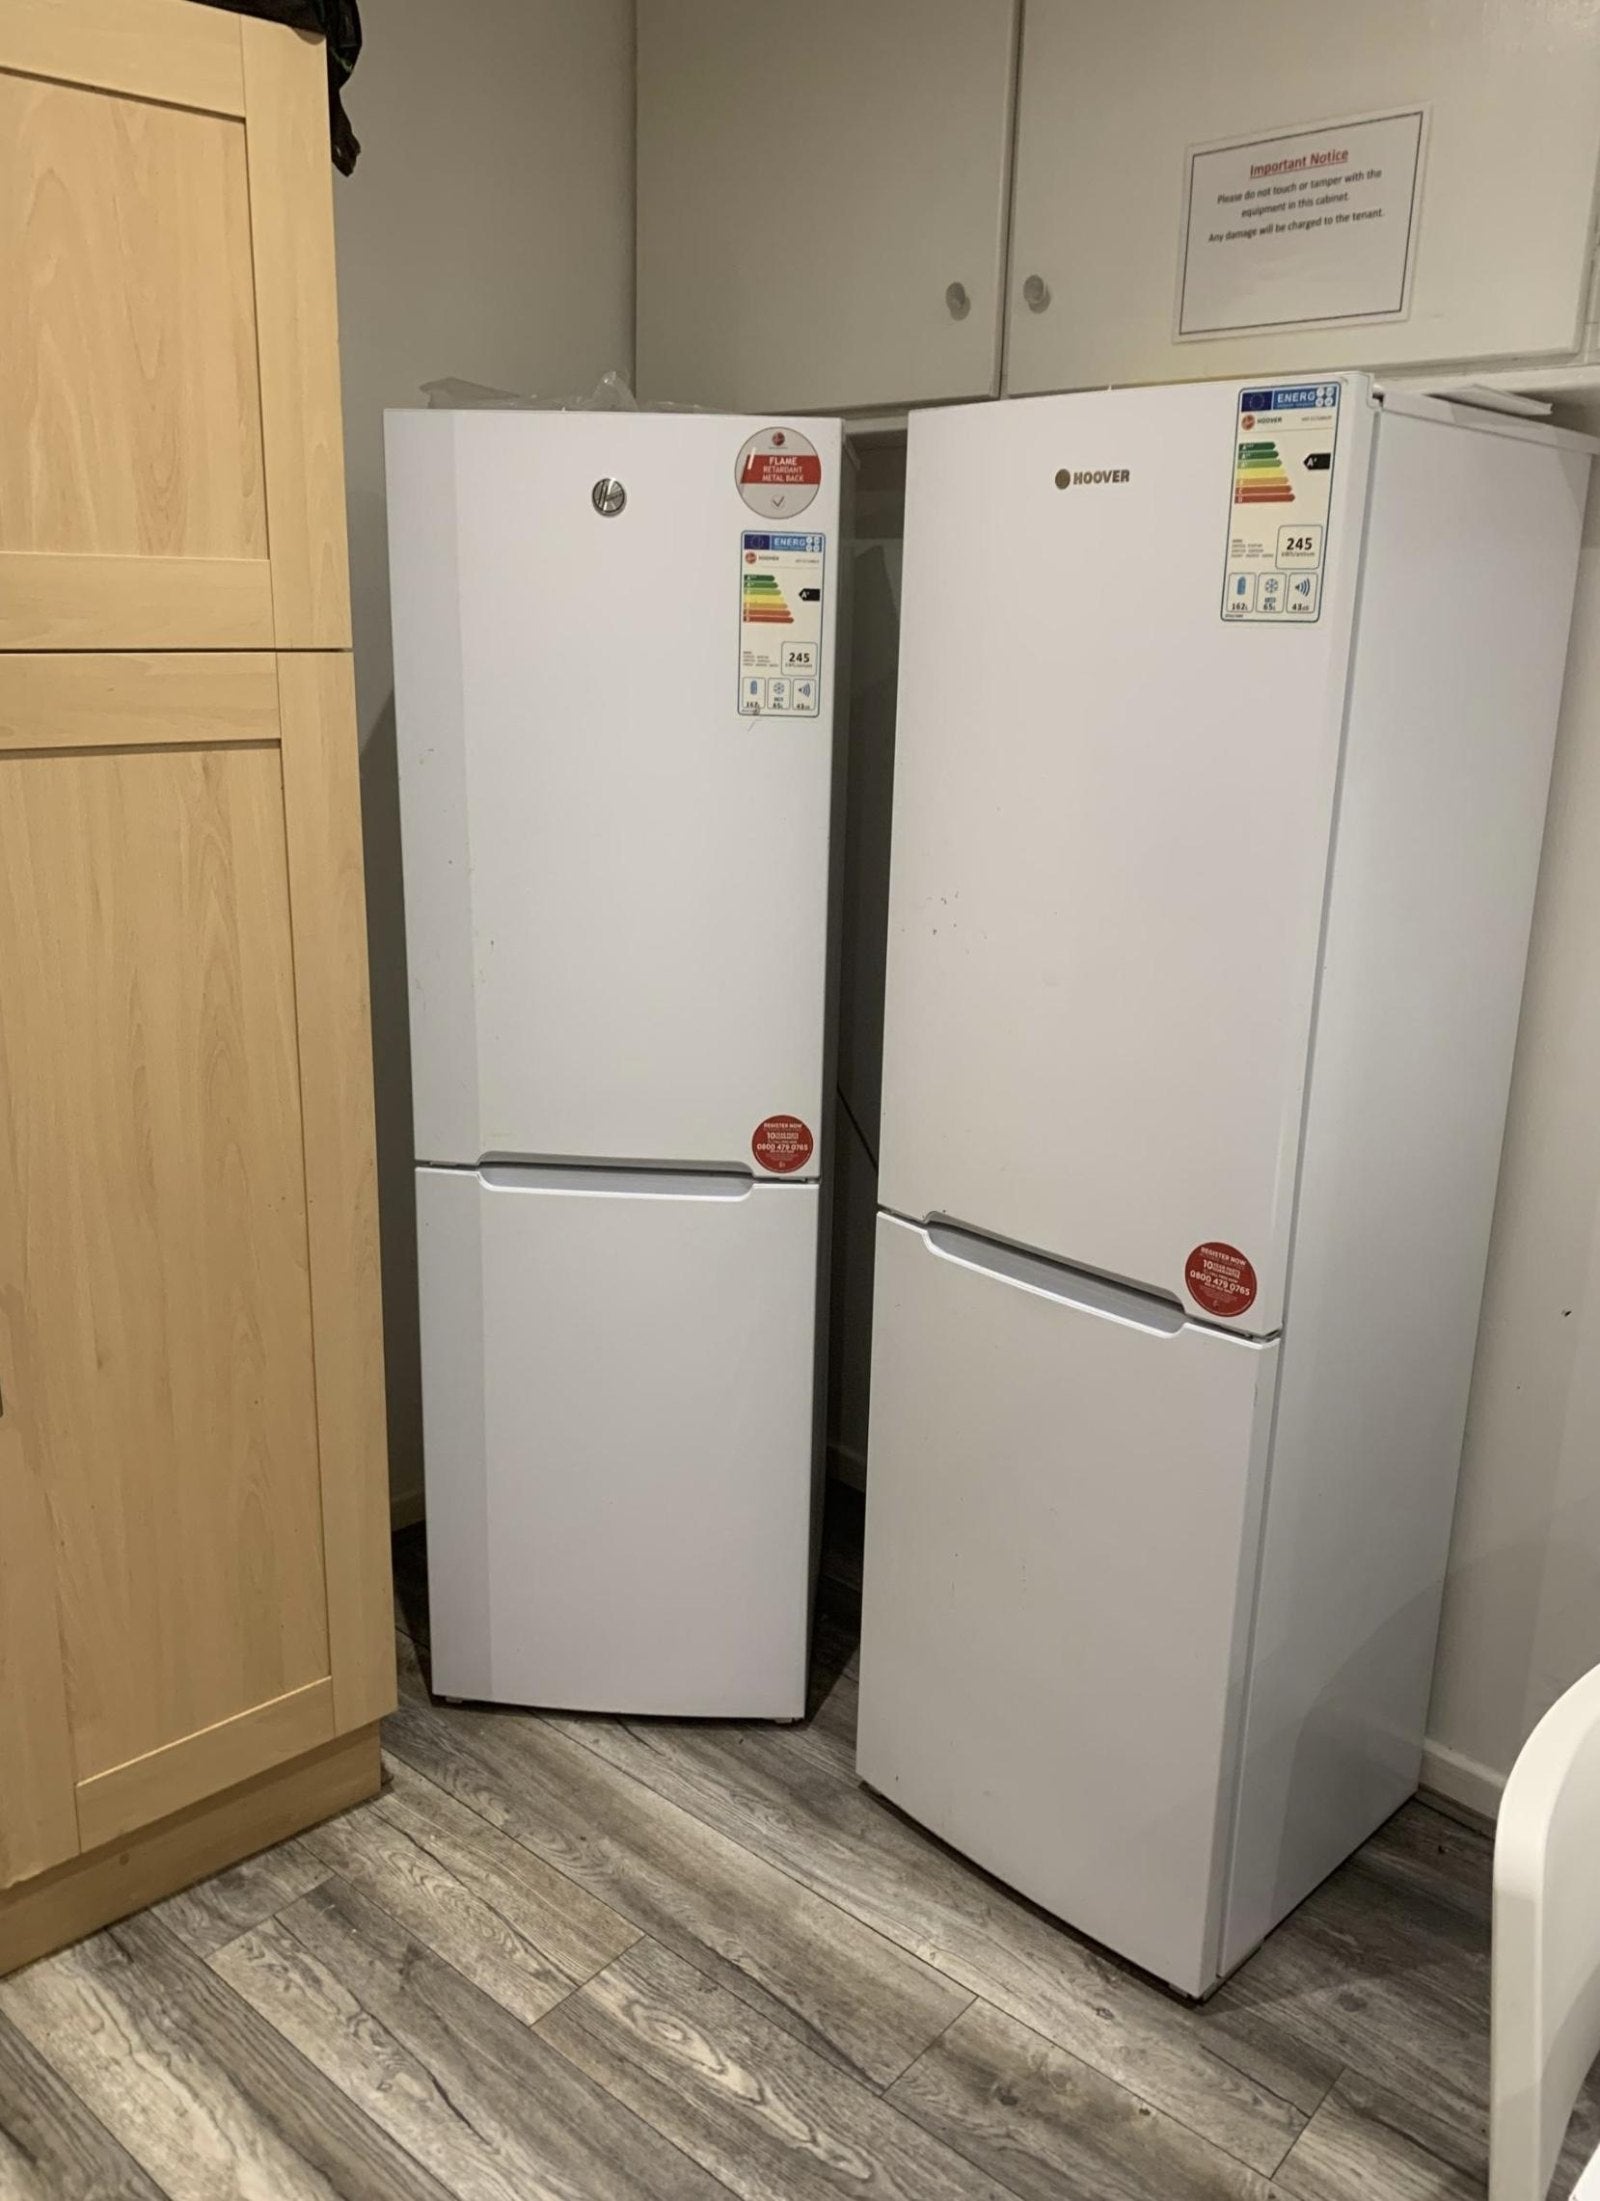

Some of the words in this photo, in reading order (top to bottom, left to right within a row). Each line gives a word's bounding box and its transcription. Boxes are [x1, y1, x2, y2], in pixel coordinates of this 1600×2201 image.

[1250, 156, 1306, 178] Important
[1310, 149, 1349, 165] Notice
[1217, 193, 1243, 204] Please
[1244, 190, 1255, 200] do
[1257, 187, 1271, 197] not
[1273, 182, 1297, 195] touch
[1299, 182, 1308, 191] or
[1310, 176, 1342, 188] tamper
[1345, 170, 1364, 183] with
[1367, 169, 1382, 179] the
[1241, 202, 1286, 218] equipment
[1288, 201, 1296, 210] in
[1298, 198, 1314, 208] this
[1208, 233, 1223, 242] Any
[1225, 228, 1257, 239] damage
[1259, 223, 1273, 235] will
[1275, 223, 1286, 232] be
[1287, 216, 1322, 230] charged
[1324, 216, 1333, 225] to
[1335, 213, 1350, 223] the
[1277, 391, 1316, 404] ENERG
[769, 456, 798, 466] FLAME
[763, 465, 803, 474] RETARDANT
[762, 474, 784, 482] METAL
[784, 474, 805, 482] BACK
[1073, 469, 1131, 485] HOOVER
[773, 537, 806, 547] ENERG
[1286, 537, 1313, 551] 245
[789, 652, 811, 664] 245
[1203, 1259, 1214, 1270] 10
[1230, 1256, 1247, 1266] NOW
[1190, 1269, 1212, 1283] 0800
[1212, 1278, 1228, 1288] 479
[1229, 1283, 1250, 1296] 0765
